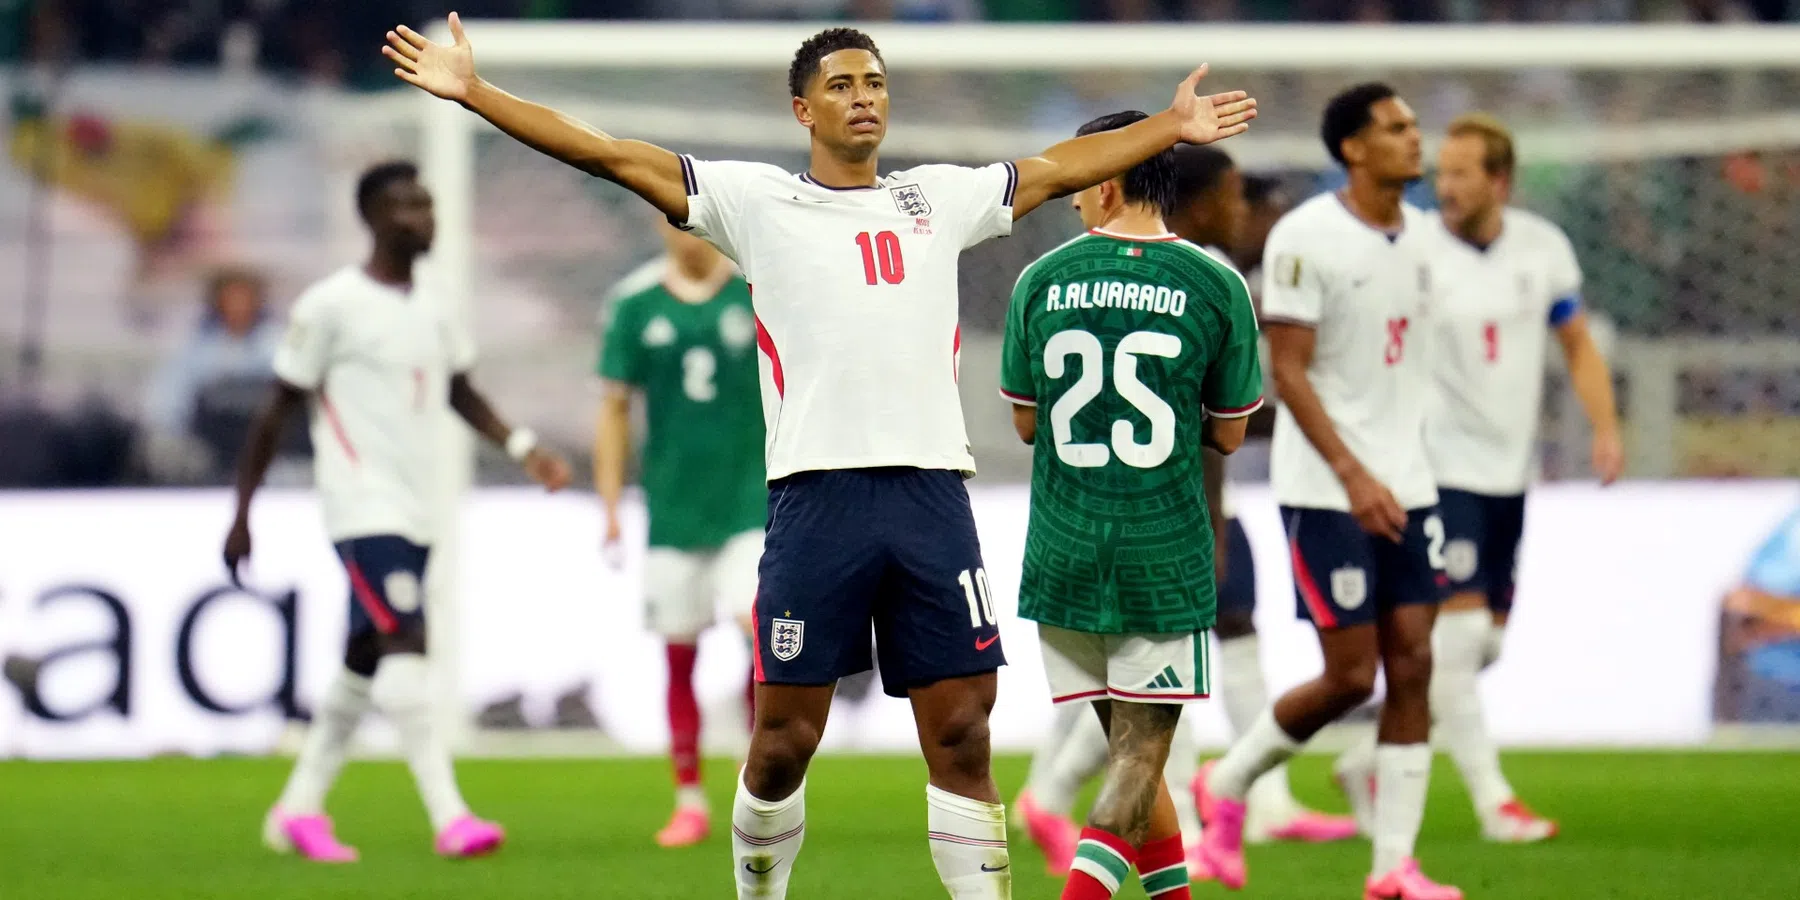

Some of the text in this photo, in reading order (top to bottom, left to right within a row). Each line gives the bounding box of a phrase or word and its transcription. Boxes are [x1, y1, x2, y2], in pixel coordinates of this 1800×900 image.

[855, 230, 905, 285] 10
[1046, 281, 1187, 317] R.ALVARADO
[1043, 329, 1182, 469] 25
[958, 567, 997, 628] 10
